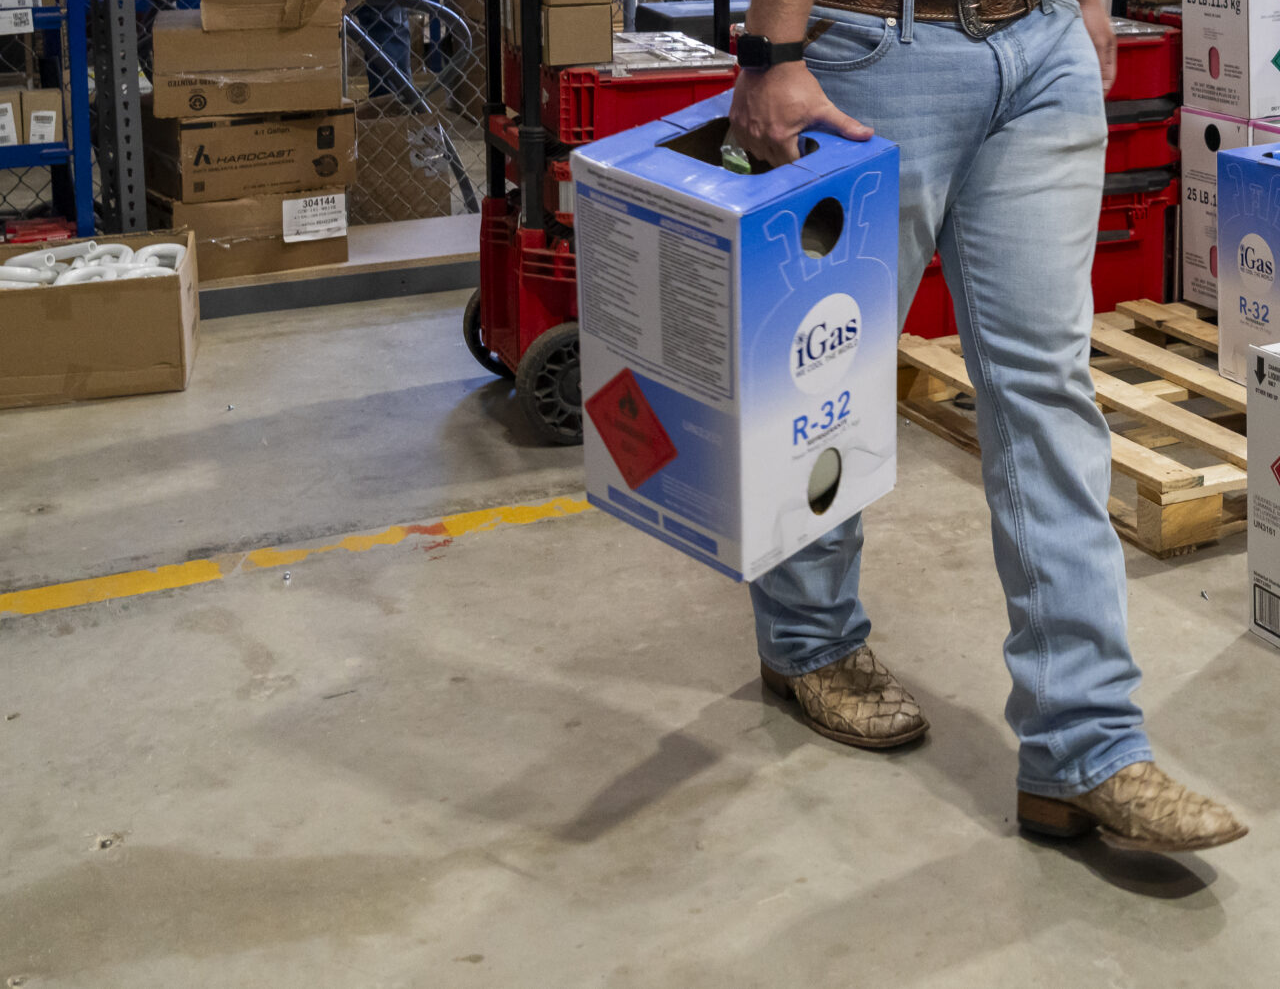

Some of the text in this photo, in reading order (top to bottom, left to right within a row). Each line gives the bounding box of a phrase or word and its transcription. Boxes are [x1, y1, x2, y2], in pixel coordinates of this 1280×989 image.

[217, 149, 295, 164] HARDCAST
[302, 196, 336, 208] 304144
[1240, 245, 1273, 274] iGas
[1239, 297, 1270, 324] R-32
[795, 319, 858, 368] iGas
[792, 390, 851, 446] R-32
[1253, 521, 1276, 537] UN3161
